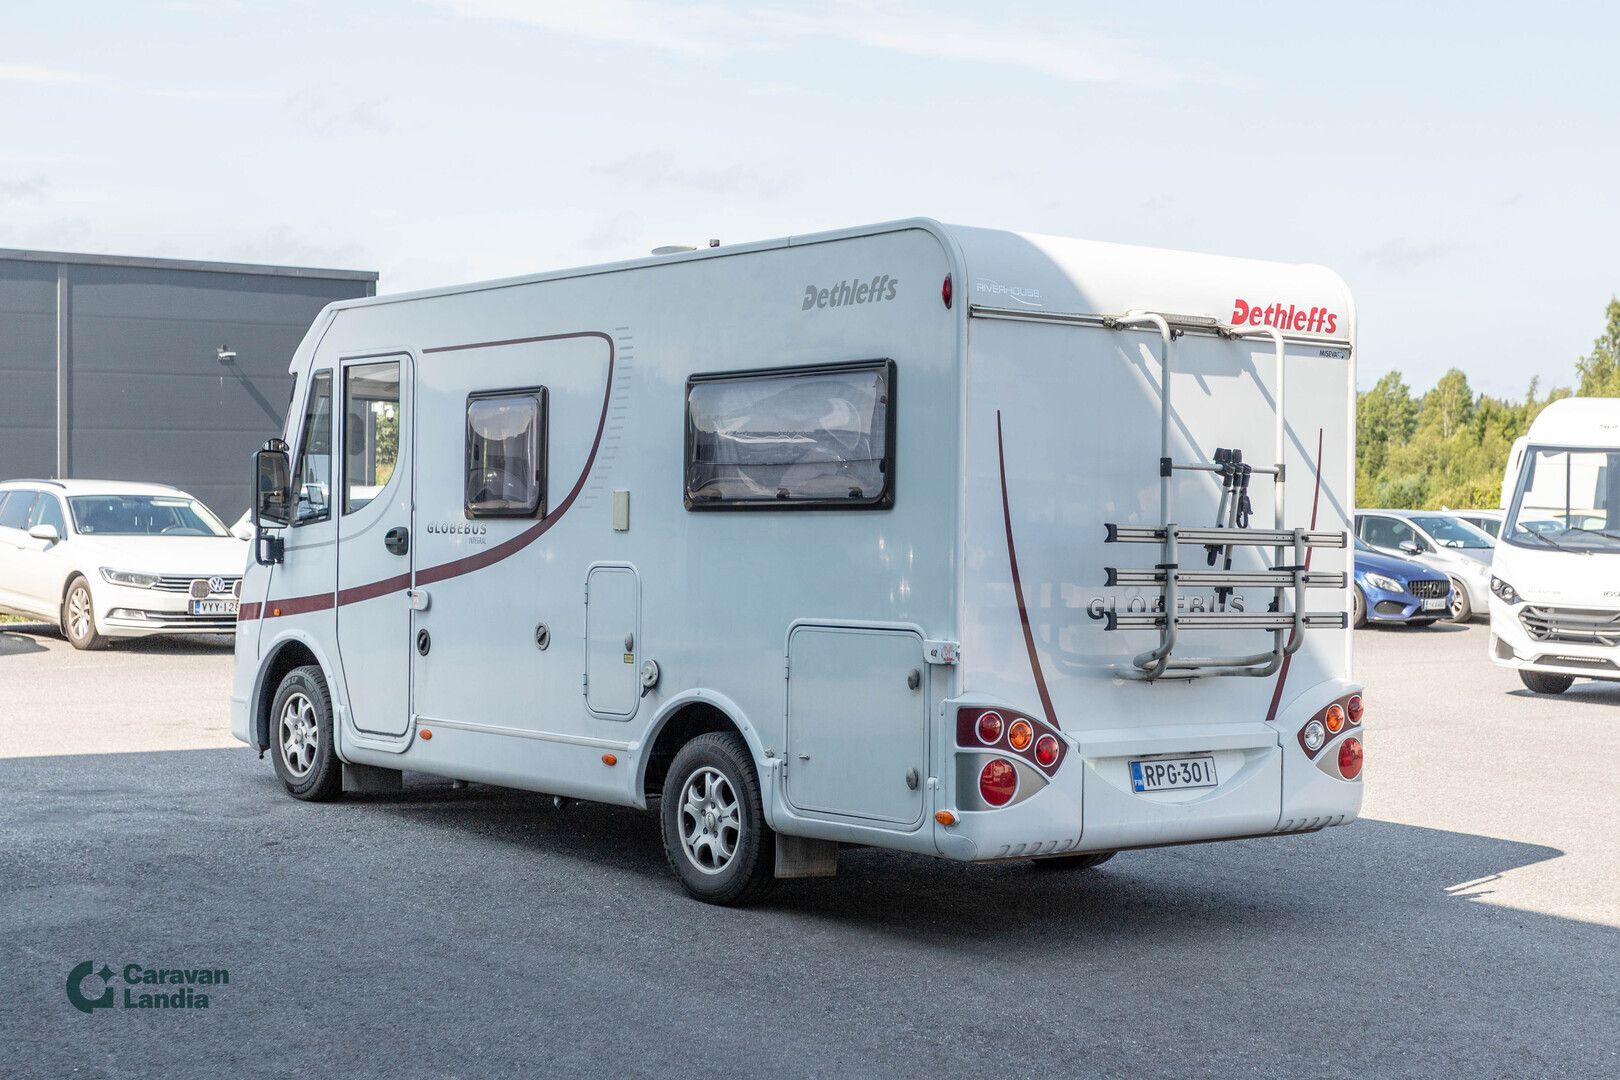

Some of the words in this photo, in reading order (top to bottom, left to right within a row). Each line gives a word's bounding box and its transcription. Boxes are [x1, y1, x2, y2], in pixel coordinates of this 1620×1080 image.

[802, 274, 899, 311] Dethleffs
[1230, 298, 1338, 334] Dethleffs
[426, 522, 487, 535] GLOBEBUS
[1144, 761, 1211, 787] RPG-301
